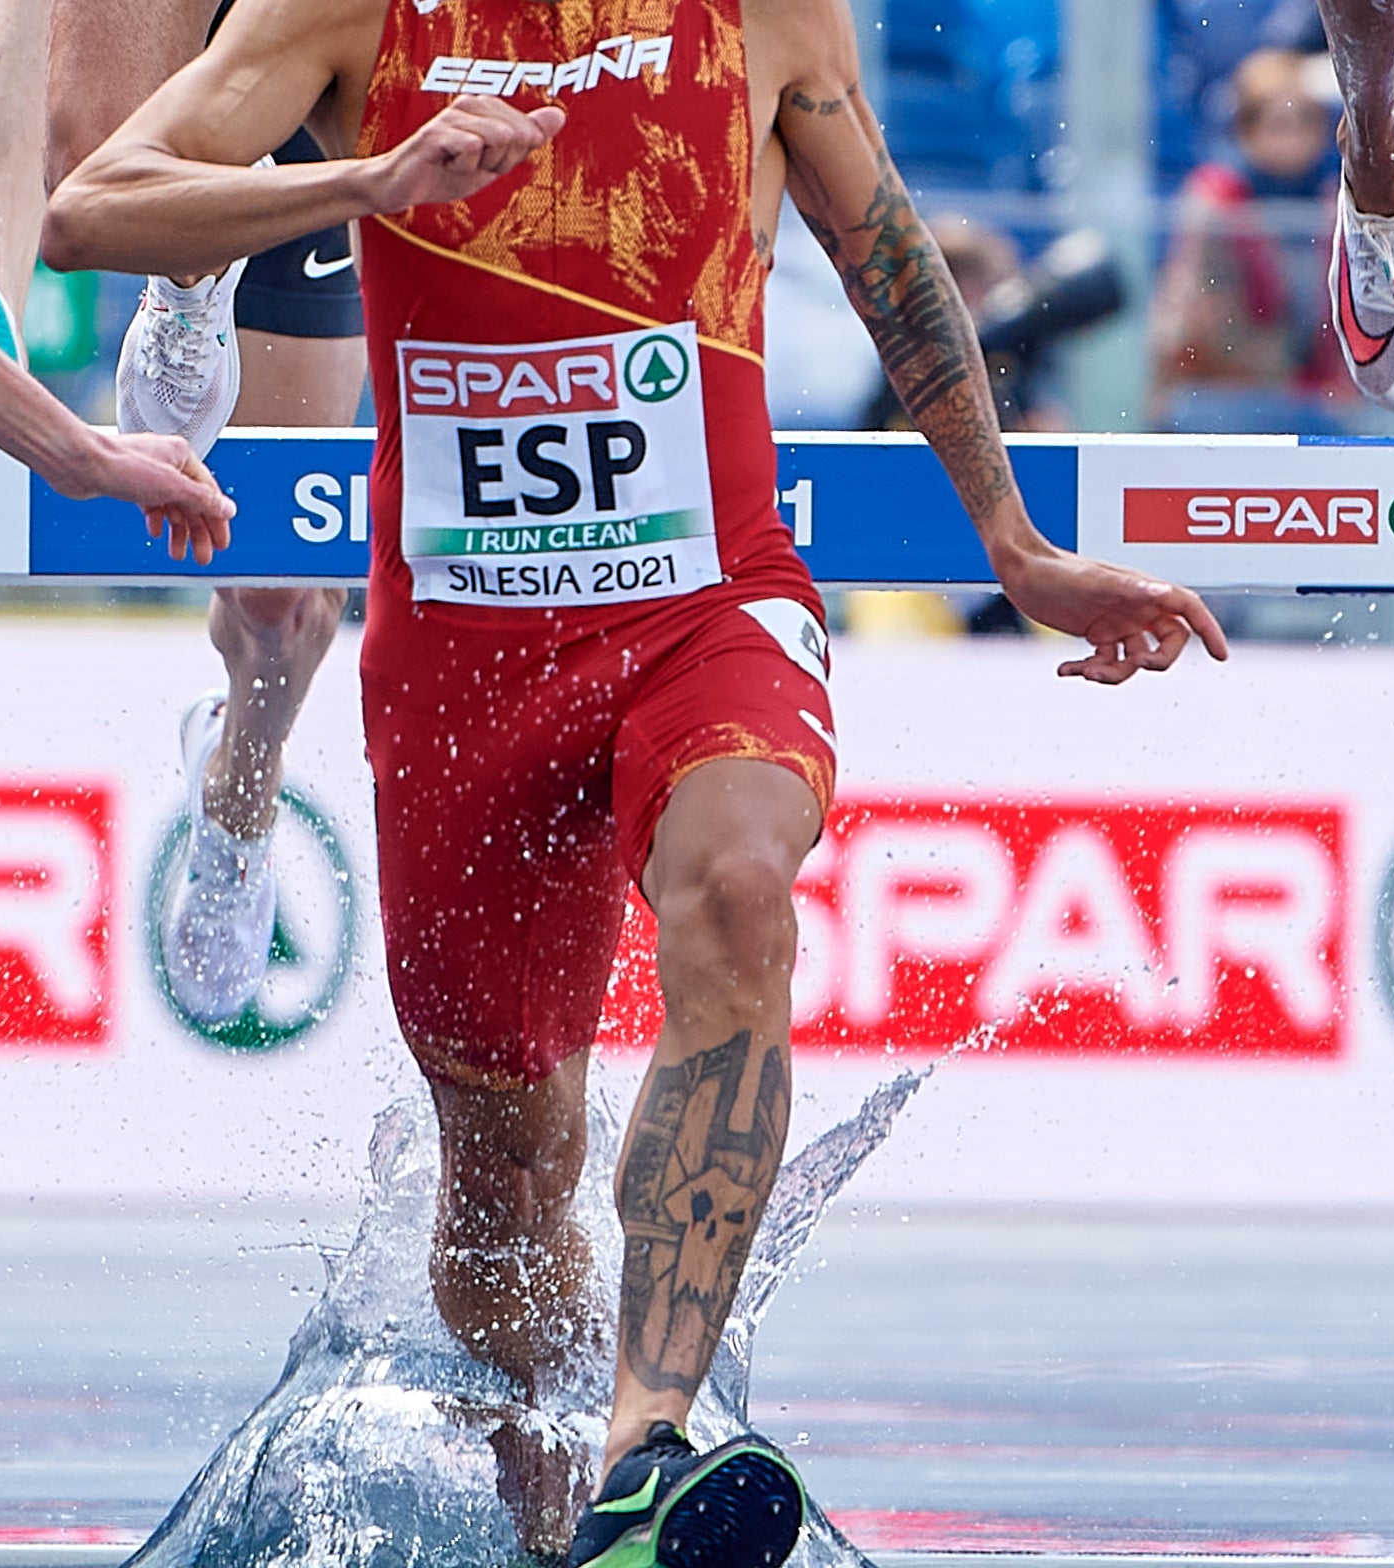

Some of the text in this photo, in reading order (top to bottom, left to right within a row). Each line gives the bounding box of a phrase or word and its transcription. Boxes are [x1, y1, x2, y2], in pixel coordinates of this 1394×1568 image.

[420, 33, 674, 97] ESPAÑA
[408, 356, 614, 409] SPAR
[457, 420, 648, 518] ESP
[481, 528, 540, 551] RUN
[1186, 496, 1374, 537] SPAR
[448, 554, 677, 597] SILESIA 2021
